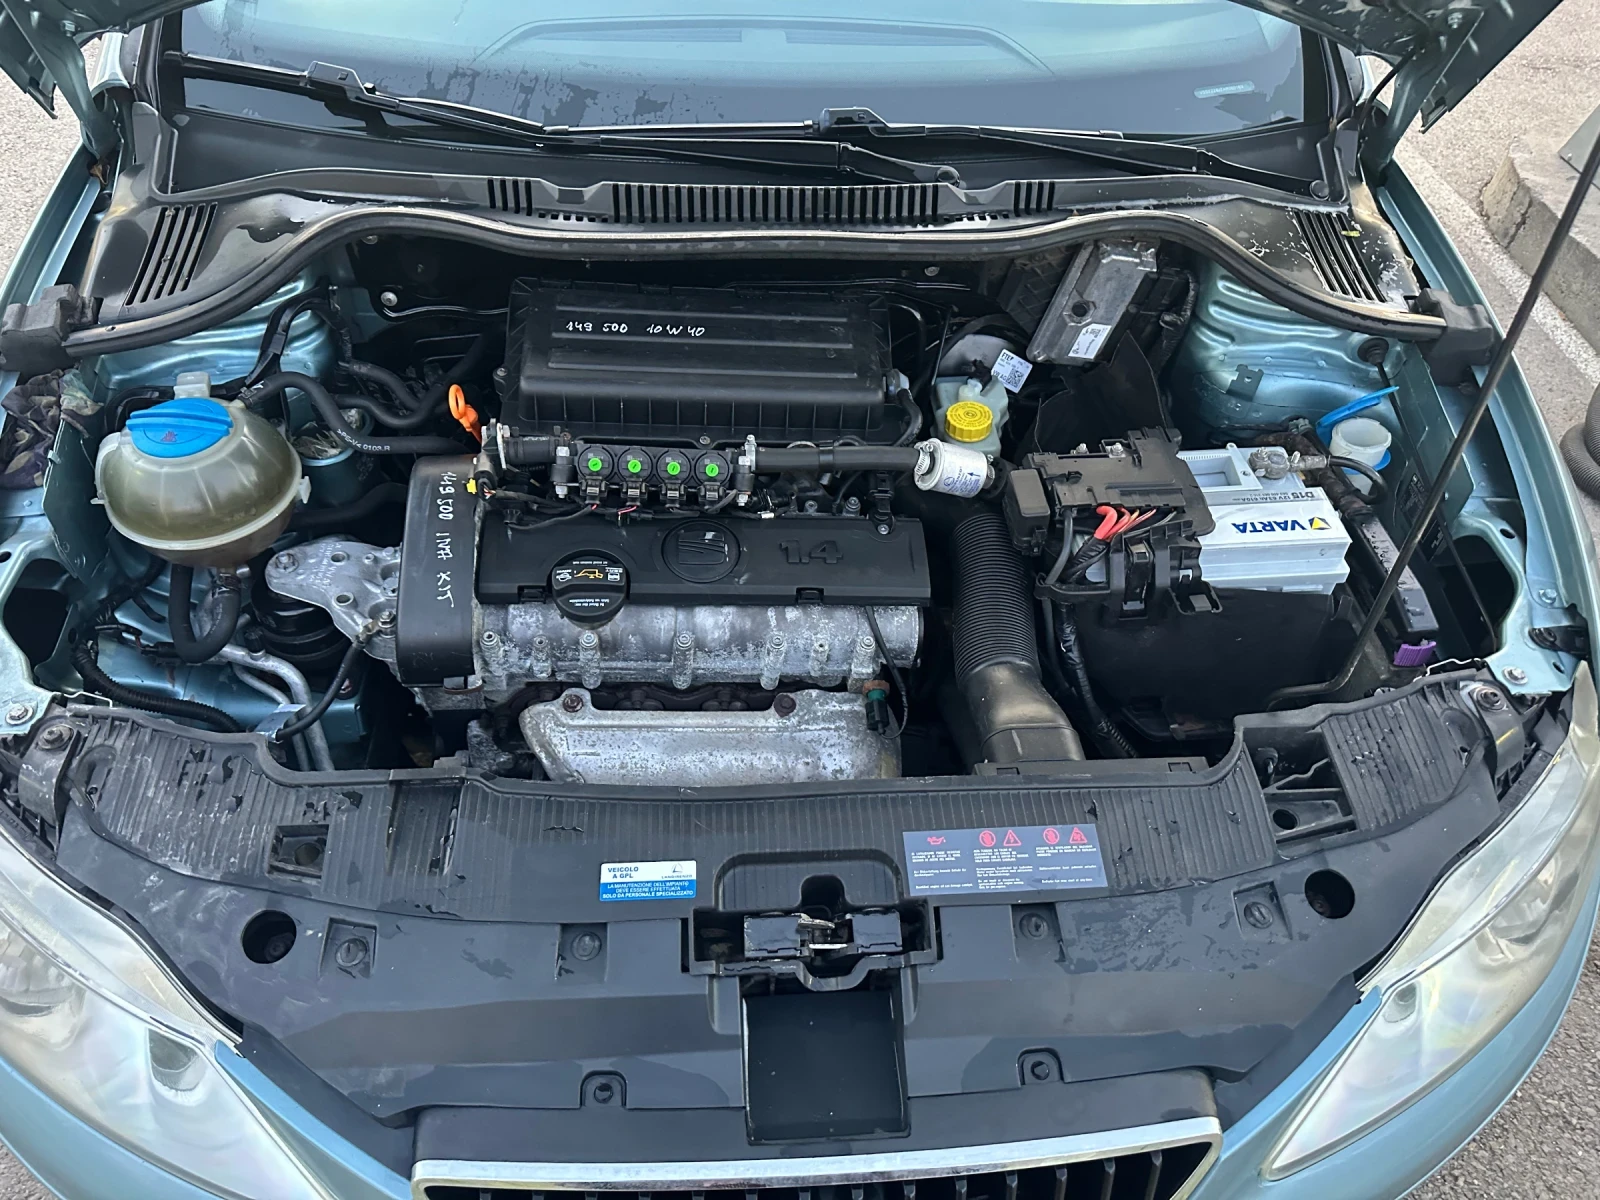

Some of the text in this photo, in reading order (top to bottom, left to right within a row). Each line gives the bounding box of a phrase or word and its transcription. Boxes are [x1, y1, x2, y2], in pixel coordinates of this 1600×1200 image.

[602, 323, 628, 334] 500
[1291, 491, 1315, 500] D15
[436, 498, 454, 520] 500
[1231, 519, 1308, 534] VARTA
[780, 540, 843, 564] 1.4
[436, 571, 454, 608] KIT
